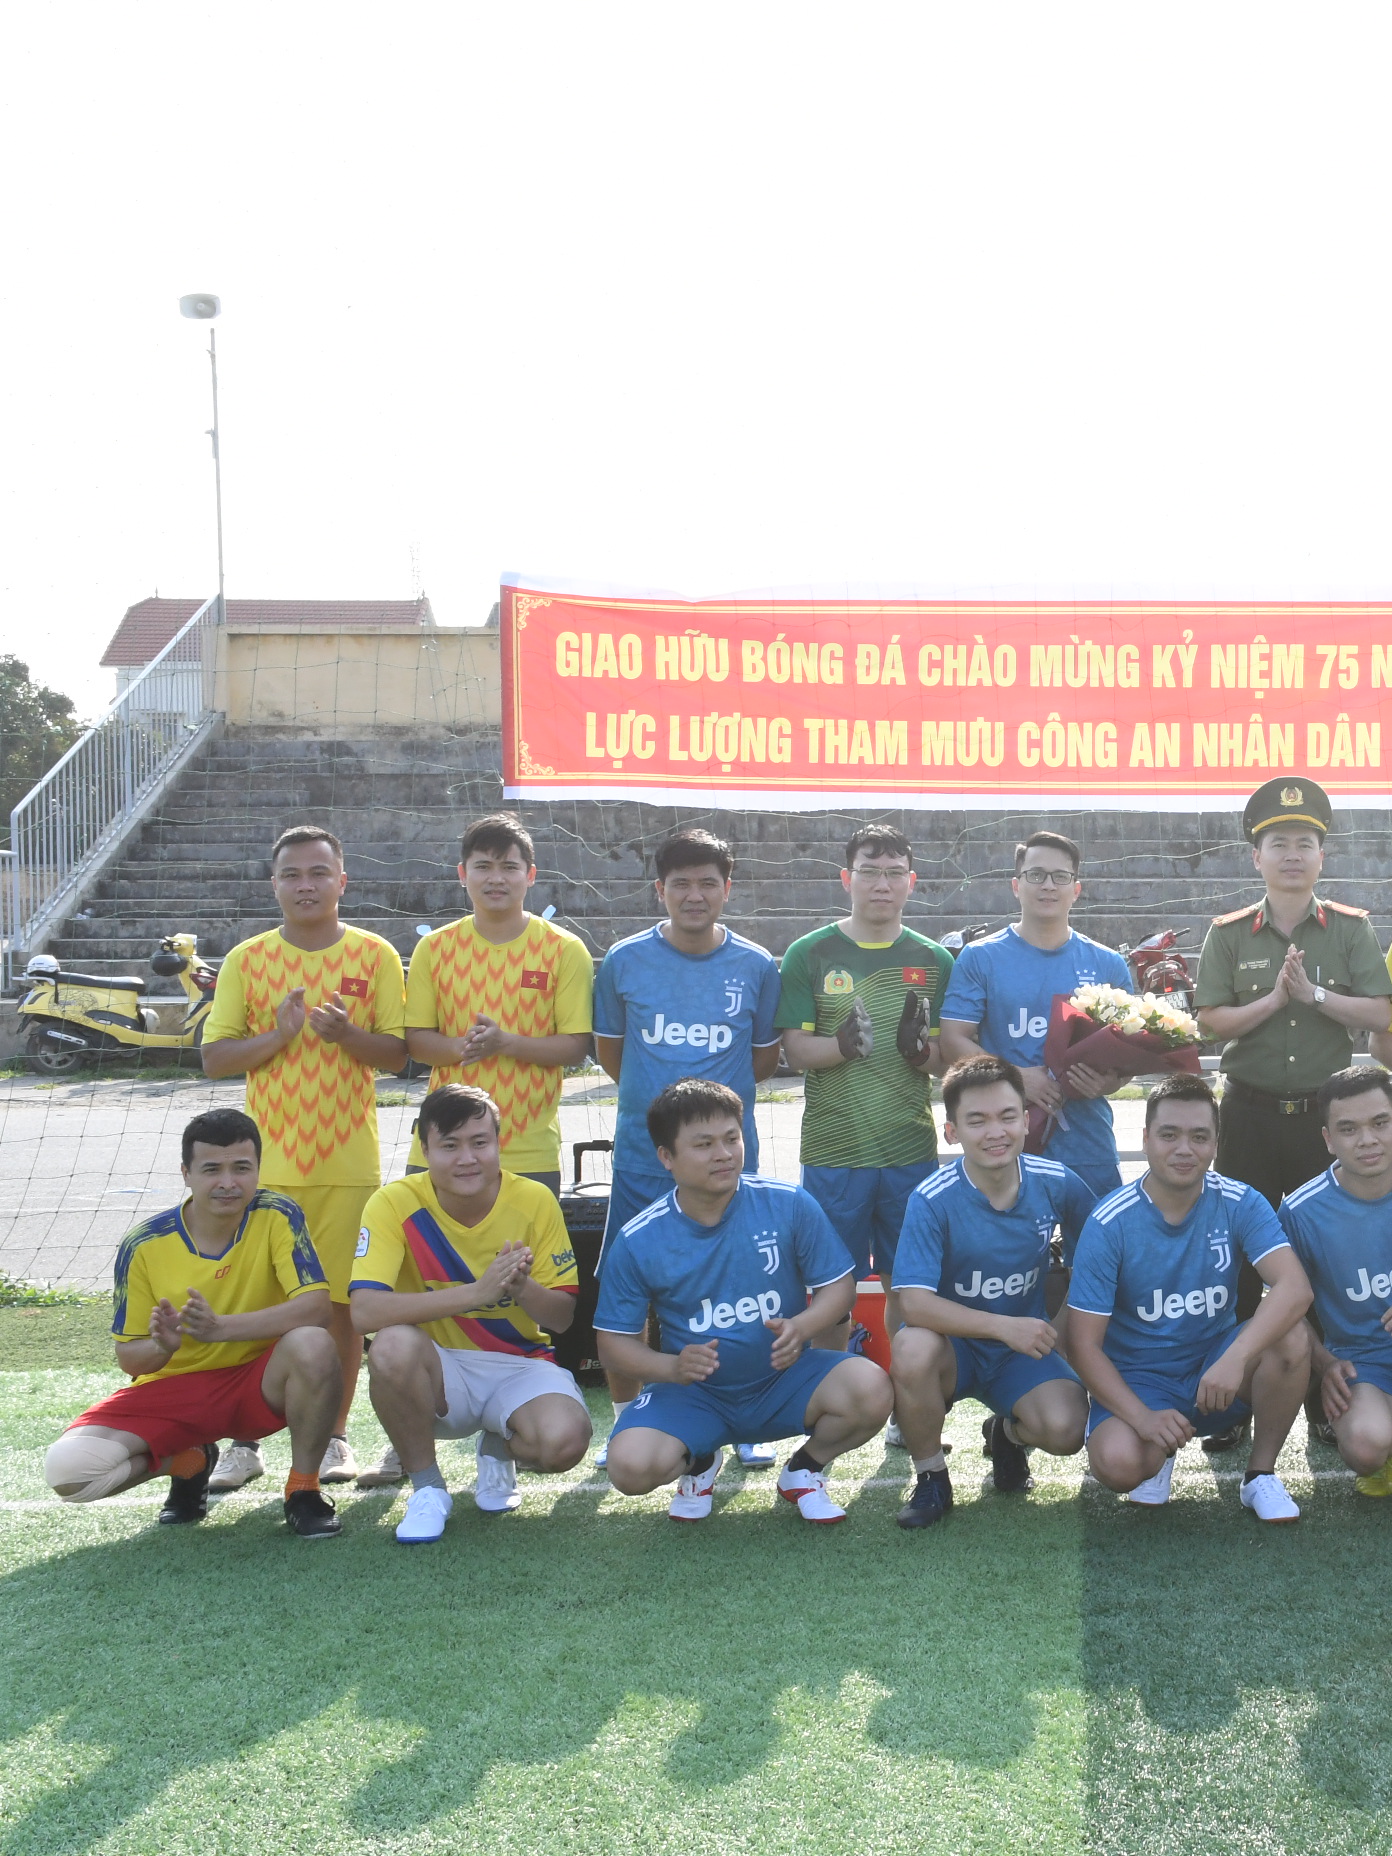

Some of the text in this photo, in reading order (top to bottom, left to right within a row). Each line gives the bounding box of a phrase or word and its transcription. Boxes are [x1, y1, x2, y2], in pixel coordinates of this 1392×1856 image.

[556, 632, 643, 680] GIAO
[655, 629, 730, 682] HỮU
[742, 634, 844, 685] BÓNG
[855, 635, 907, 686] ĐÁ
[918, 636, 1017, 688] CHÀO
[1030, 635, 1140, 689] MỪNG
[1153, 629, 1199, 689] KỶ
[1211, 635, 1305, 699] NIỆM
[1316, 644, 1360, 690] 75
[586, 710, 657, 769] LỰC
[669, 712, 792, 773] LƯỢNG
[804, 719, 908, 766] THAM
[921, 718, 1005, 767] MƯU
[1018, 711, 1118, 768] CÔNG
[1129, 722, 1181, 768] AN
[1193, 713, 1295, 768] NHÂN
[1307, 712, 1381, 768] DÂN
[641, 1013, 733, 1053] Jeep
[1007, 1007, 1048, 1038] Je
[551, 1248, 576, 1267] bek
[955, 1267, 1040, 1300] Jeep
[688, 1289, 781, 1333] Jeep
[1136, 1285, 1229, 1322] Jeep
